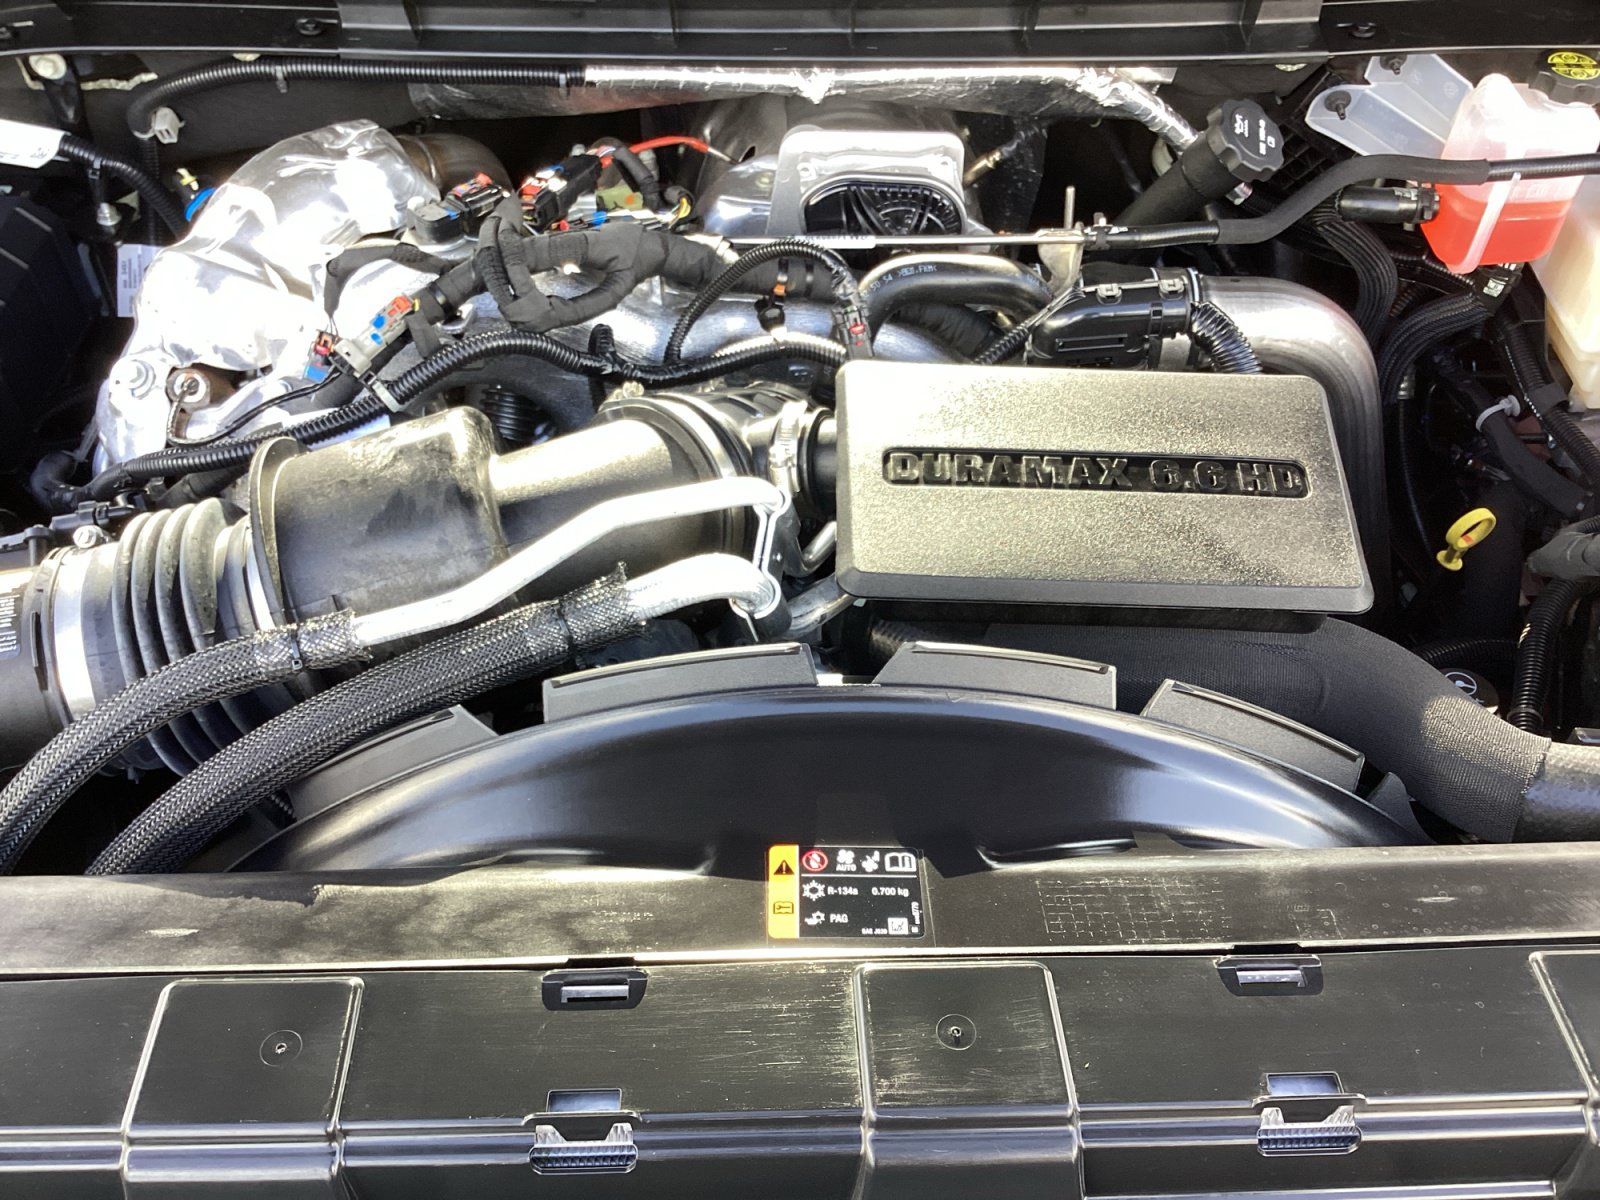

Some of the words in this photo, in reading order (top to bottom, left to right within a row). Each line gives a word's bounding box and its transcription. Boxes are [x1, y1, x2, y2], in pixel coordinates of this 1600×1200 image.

[888, 452, 1133, 489] DURAMAX
[1149, 459, 1228, 492] 6.6
[1237, 461, 1304, 496] HD
[835, 863, 857, 872] AUTO
[827, 886, 858, 896] R-134a
[871, 886, 897, 896] 0.700
[897, 886, 910, 898] kg
[830, 913, 849, 923] PAG
